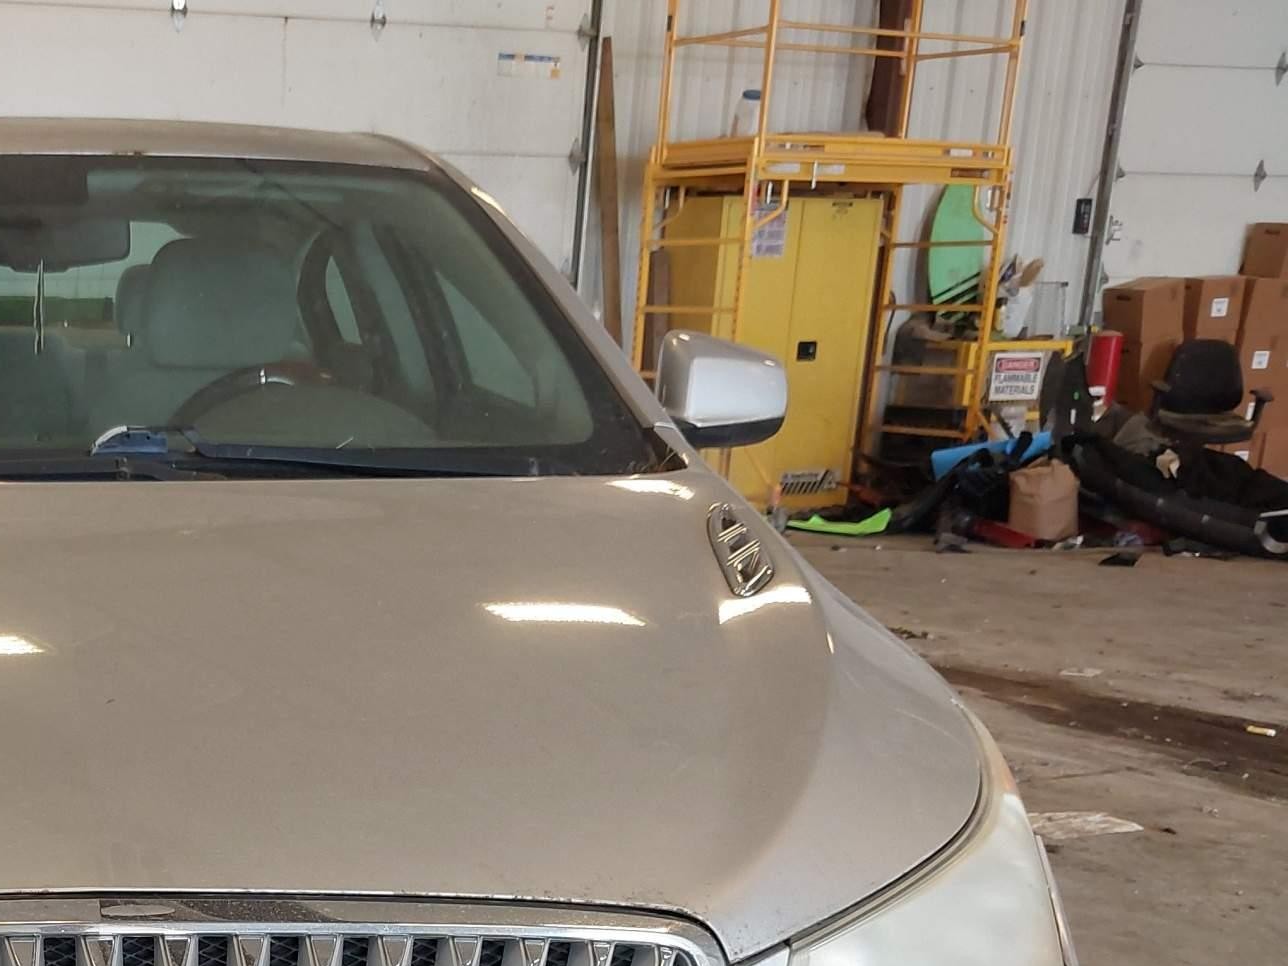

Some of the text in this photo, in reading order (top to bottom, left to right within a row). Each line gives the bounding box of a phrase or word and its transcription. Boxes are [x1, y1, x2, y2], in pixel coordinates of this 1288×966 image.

[1001, 360, 1034, 370] DANGER
[994, 373, 1038, 383] FLAMMABLE
[993, 385, 1035, 395] MATERIALS
